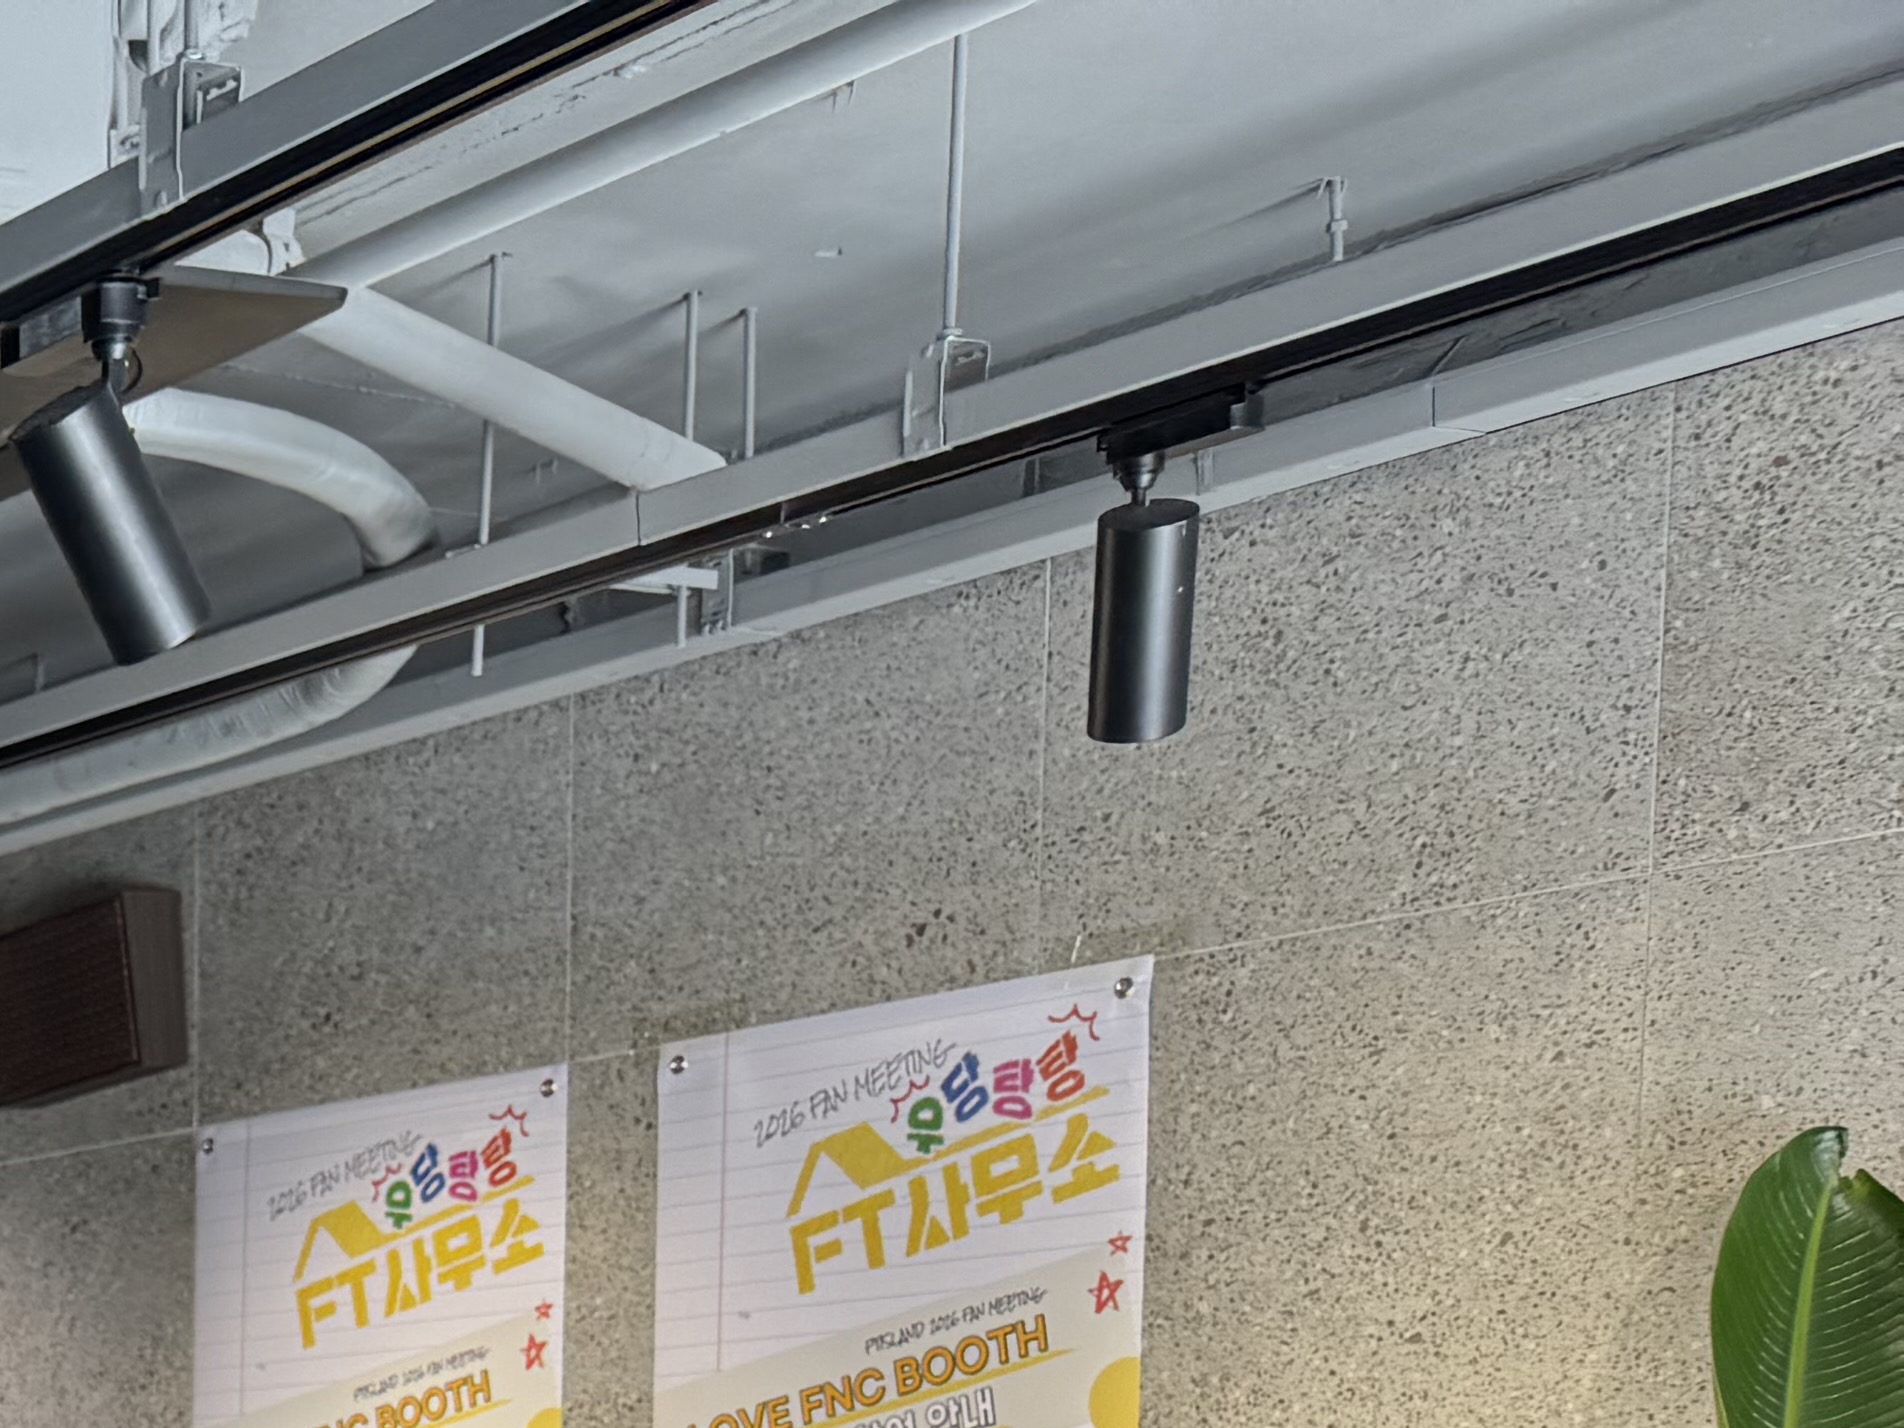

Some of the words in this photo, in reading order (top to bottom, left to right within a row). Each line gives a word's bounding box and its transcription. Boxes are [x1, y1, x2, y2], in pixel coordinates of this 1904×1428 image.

[754, 1102, 805, 1148] 2026
[809, 1081, 848, 1122] FAN
[853, 1038, 957, 1103] MEETING
[907, 1030, 1085, 1154] 우당탕탕
[789, 1112, 1120, 1296] FT사무소
[295, 1199, 544, 1349] FT사무소
[799, 1368, 887, 1426] FNC
[894, 1313, 1049, 1397] BOOTH
